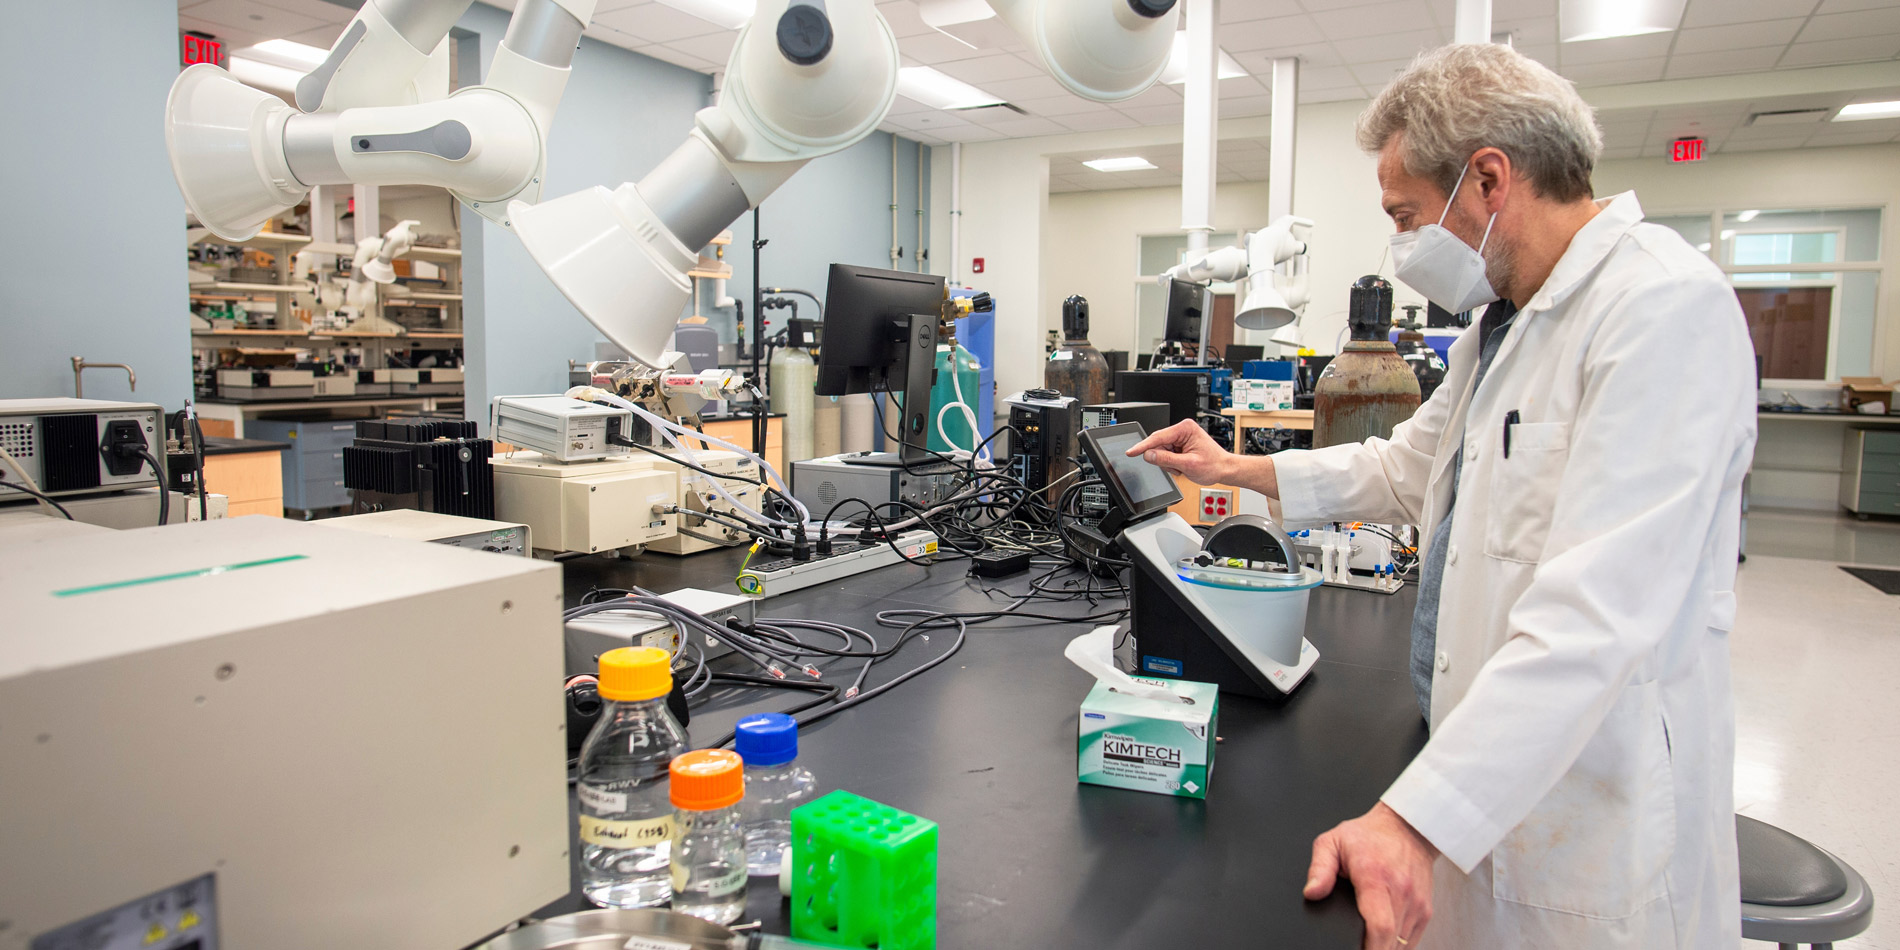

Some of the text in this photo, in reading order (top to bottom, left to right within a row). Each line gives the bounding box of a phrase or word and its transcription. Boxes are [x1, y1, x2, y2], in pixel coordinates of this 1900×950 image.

[184, 34, 221, 66] EXIT
[1673, 139, 1703, 162] EXIT
[1103, 733, 1134, 743] Kimwipes
[1103, 740, 1181, 761] KIMTECH
[593, 825, 629, 840] Ethanol
